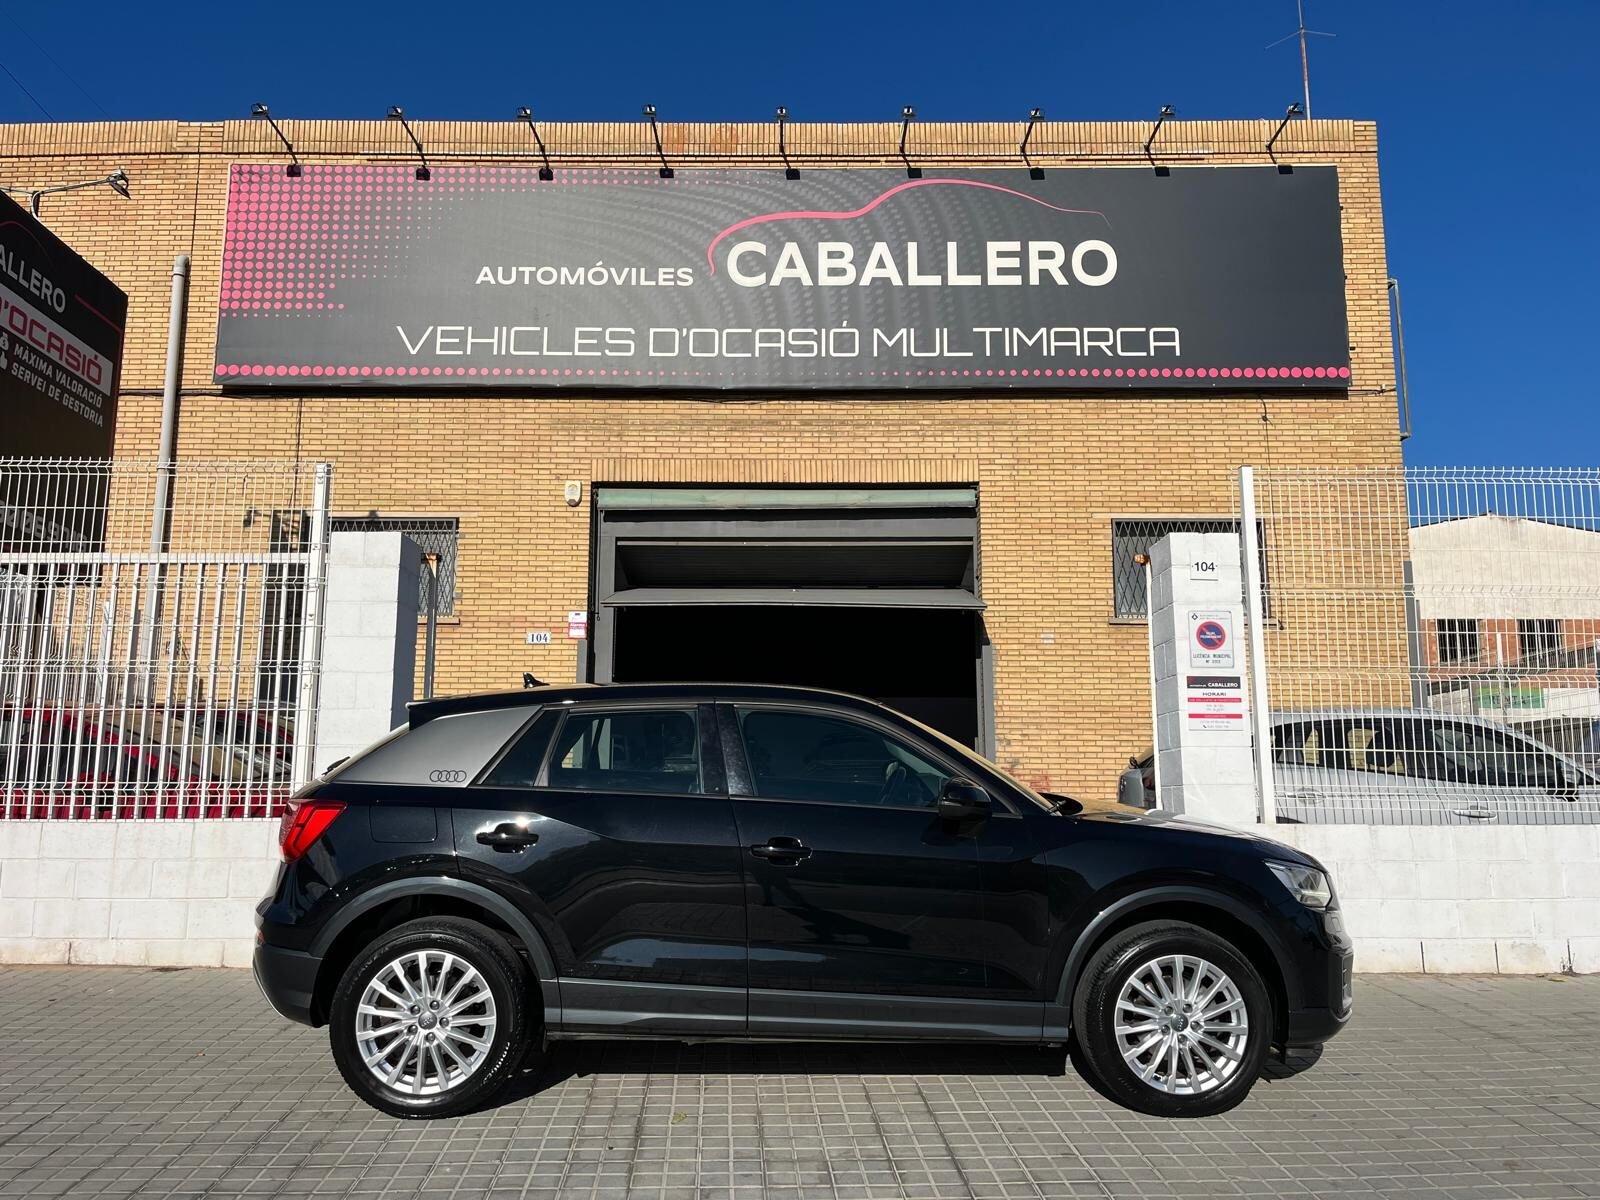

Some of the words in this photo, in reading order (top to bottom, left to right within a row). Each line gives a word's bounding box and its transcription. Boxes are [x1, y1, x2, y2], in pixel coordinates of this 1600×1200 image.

[474, 261, 694, 287] AUTOMÓVILES
[726, 239, 1118, 288] CABALLERO
[0, 297, 103, 386] 'OCASIÓ
[396, 325, 635, 356] VEHICLES
[648, 320, 860, 358] D'OCASIÓ
[873, 327, 1181, 357] MULTIMARCA
[11, 362, 47, 393] SERVEI
[48, 385, 61, 402] DE
[62, 393, 103, 427] GESTORIA
[1194, 561, 1216, 572] 104
[531, 633, 548, 642] 104
